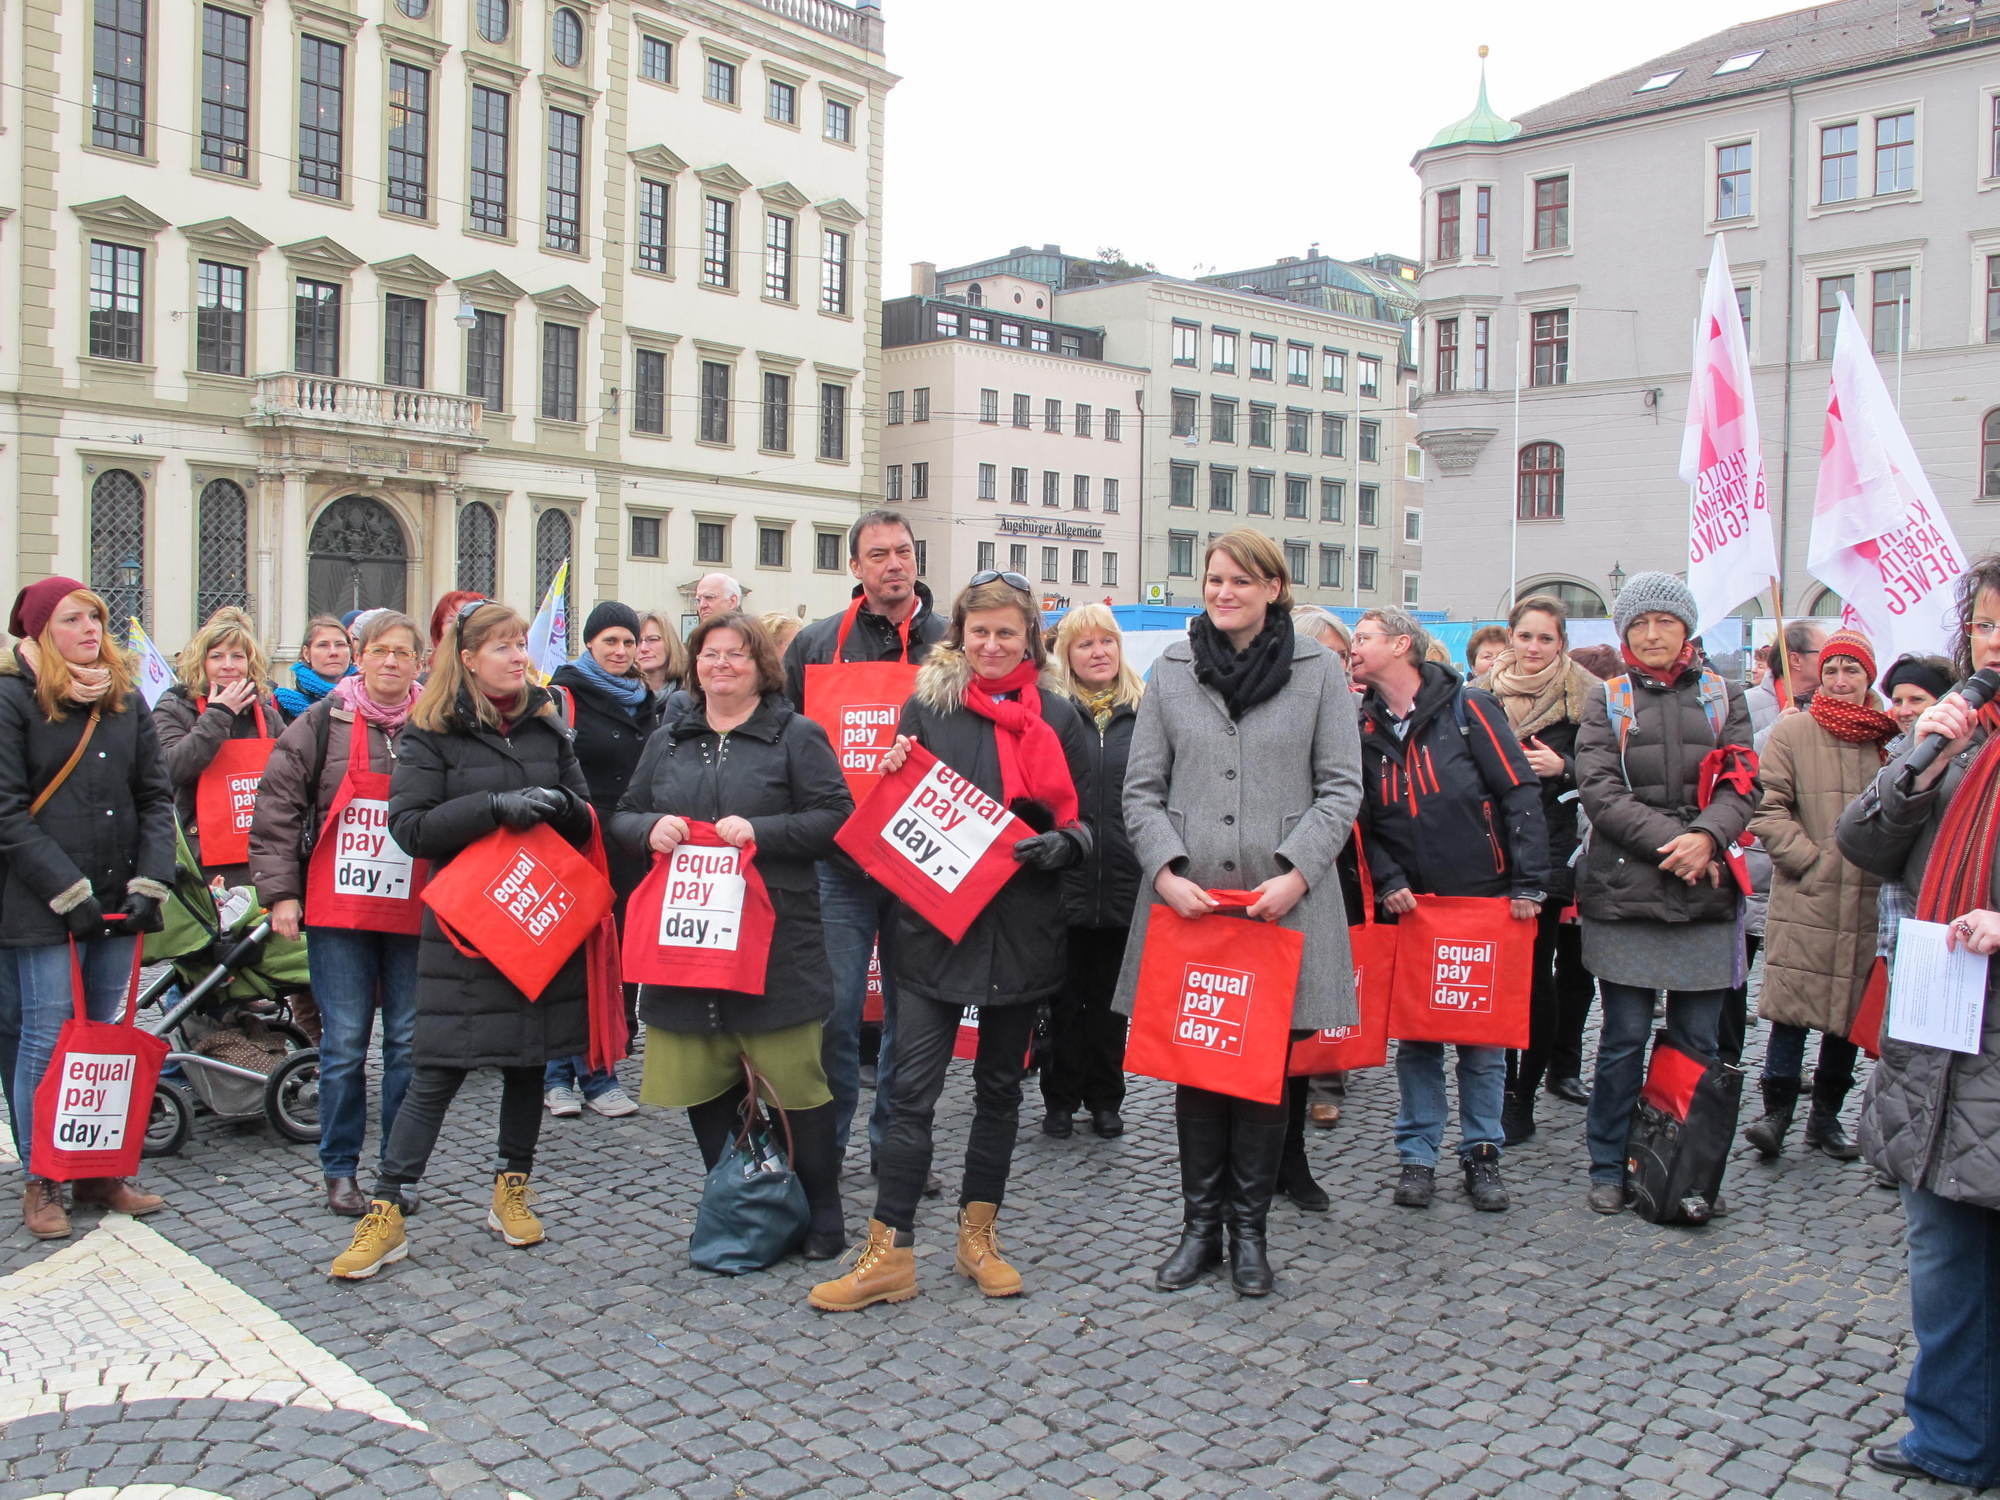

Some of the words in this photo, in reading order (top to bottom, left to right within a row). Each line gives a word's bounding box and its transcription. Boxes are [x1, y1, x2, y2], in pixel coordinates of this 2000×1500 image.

[1000, 517, 1052, 536] Augsburger
[1055, 521, 1102, 538] Allgemeine
[844, 707, 895, 728] equal
[843, 728, 878, 746] pay
[231, 777, 261, 793] equ
[936, 766, 1008, 826] equal
[236, 812, 254, 828] da
[344, 806, 388, 831] equ
[913, 785, 967, 832] pay
[341, 832, 385, 858] pay
[676, 852, 741, 879] equal
[493, 853, 536, 904] equal
[508, 882, 541, 921] pay
[670, 880, 714, 906] pay
[1437, 944, 1491, 965] equal
[1188, 971, 1249, 997] equal
[1436, 963, 1472, 983] pay
[867, 980, 883, 993] ay
[1183, 992, 1225, 1017] pay
[69, 1058, 131, 1086] equal
[64, 1087, 107, 1112] pay
